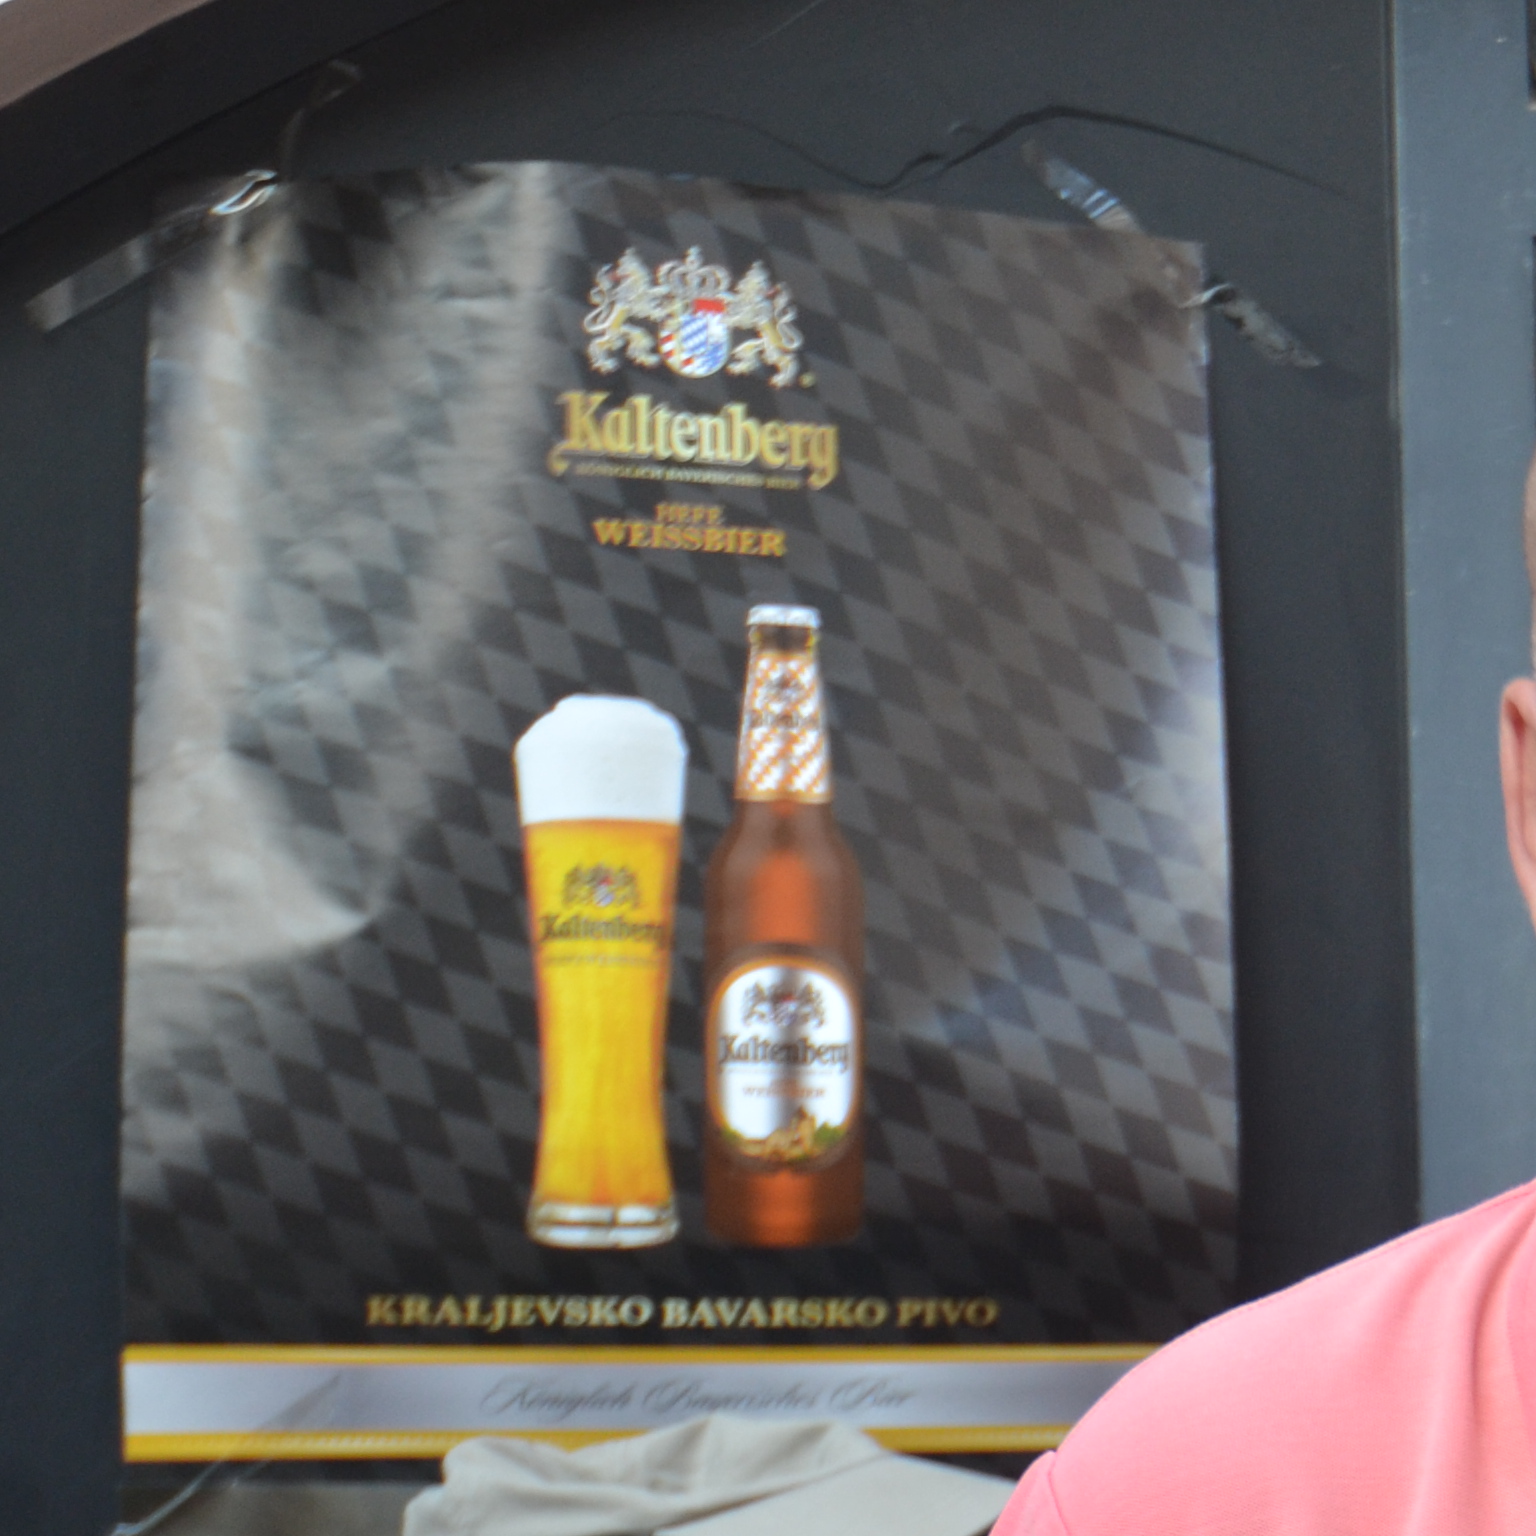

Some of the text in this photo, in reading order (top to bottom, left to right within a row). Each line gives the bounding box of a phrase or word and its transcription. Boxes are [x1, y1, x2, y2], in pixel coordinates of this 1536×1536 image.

[547, 390, 840, 490] Kaltenberg
[593, 518, 787, 557] WEISSBIER
[366, 1293, 999, 1334] KRALJEVSKO BAVARSKO PIVO
